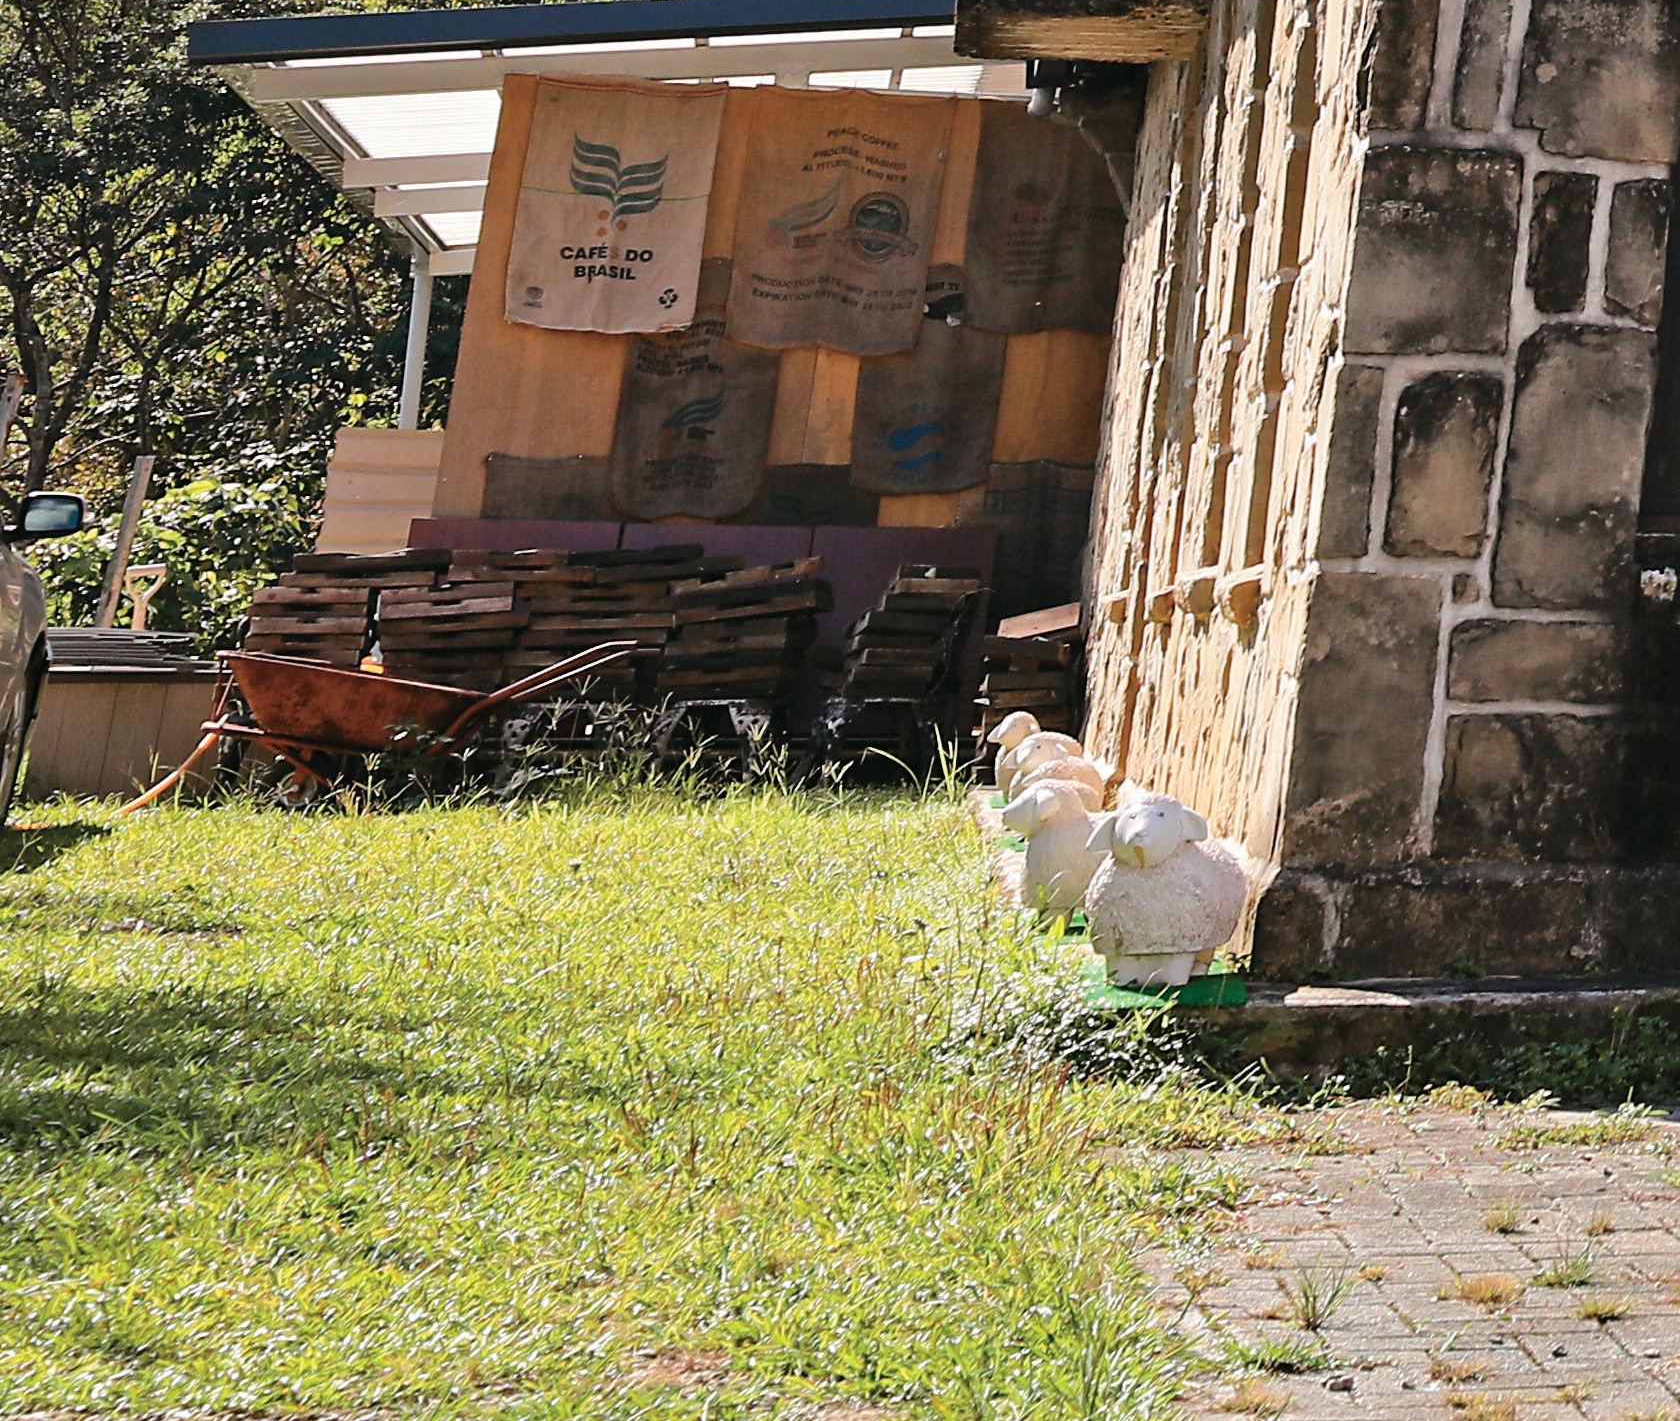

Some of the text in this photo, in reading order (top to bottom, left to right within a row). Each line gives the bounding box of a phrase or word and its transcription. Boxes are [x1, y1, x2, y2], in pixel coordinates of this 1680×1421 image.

[560, 242, 653, 263] CAFÉS DO
[574, 264, 637, 283] BRASIL
